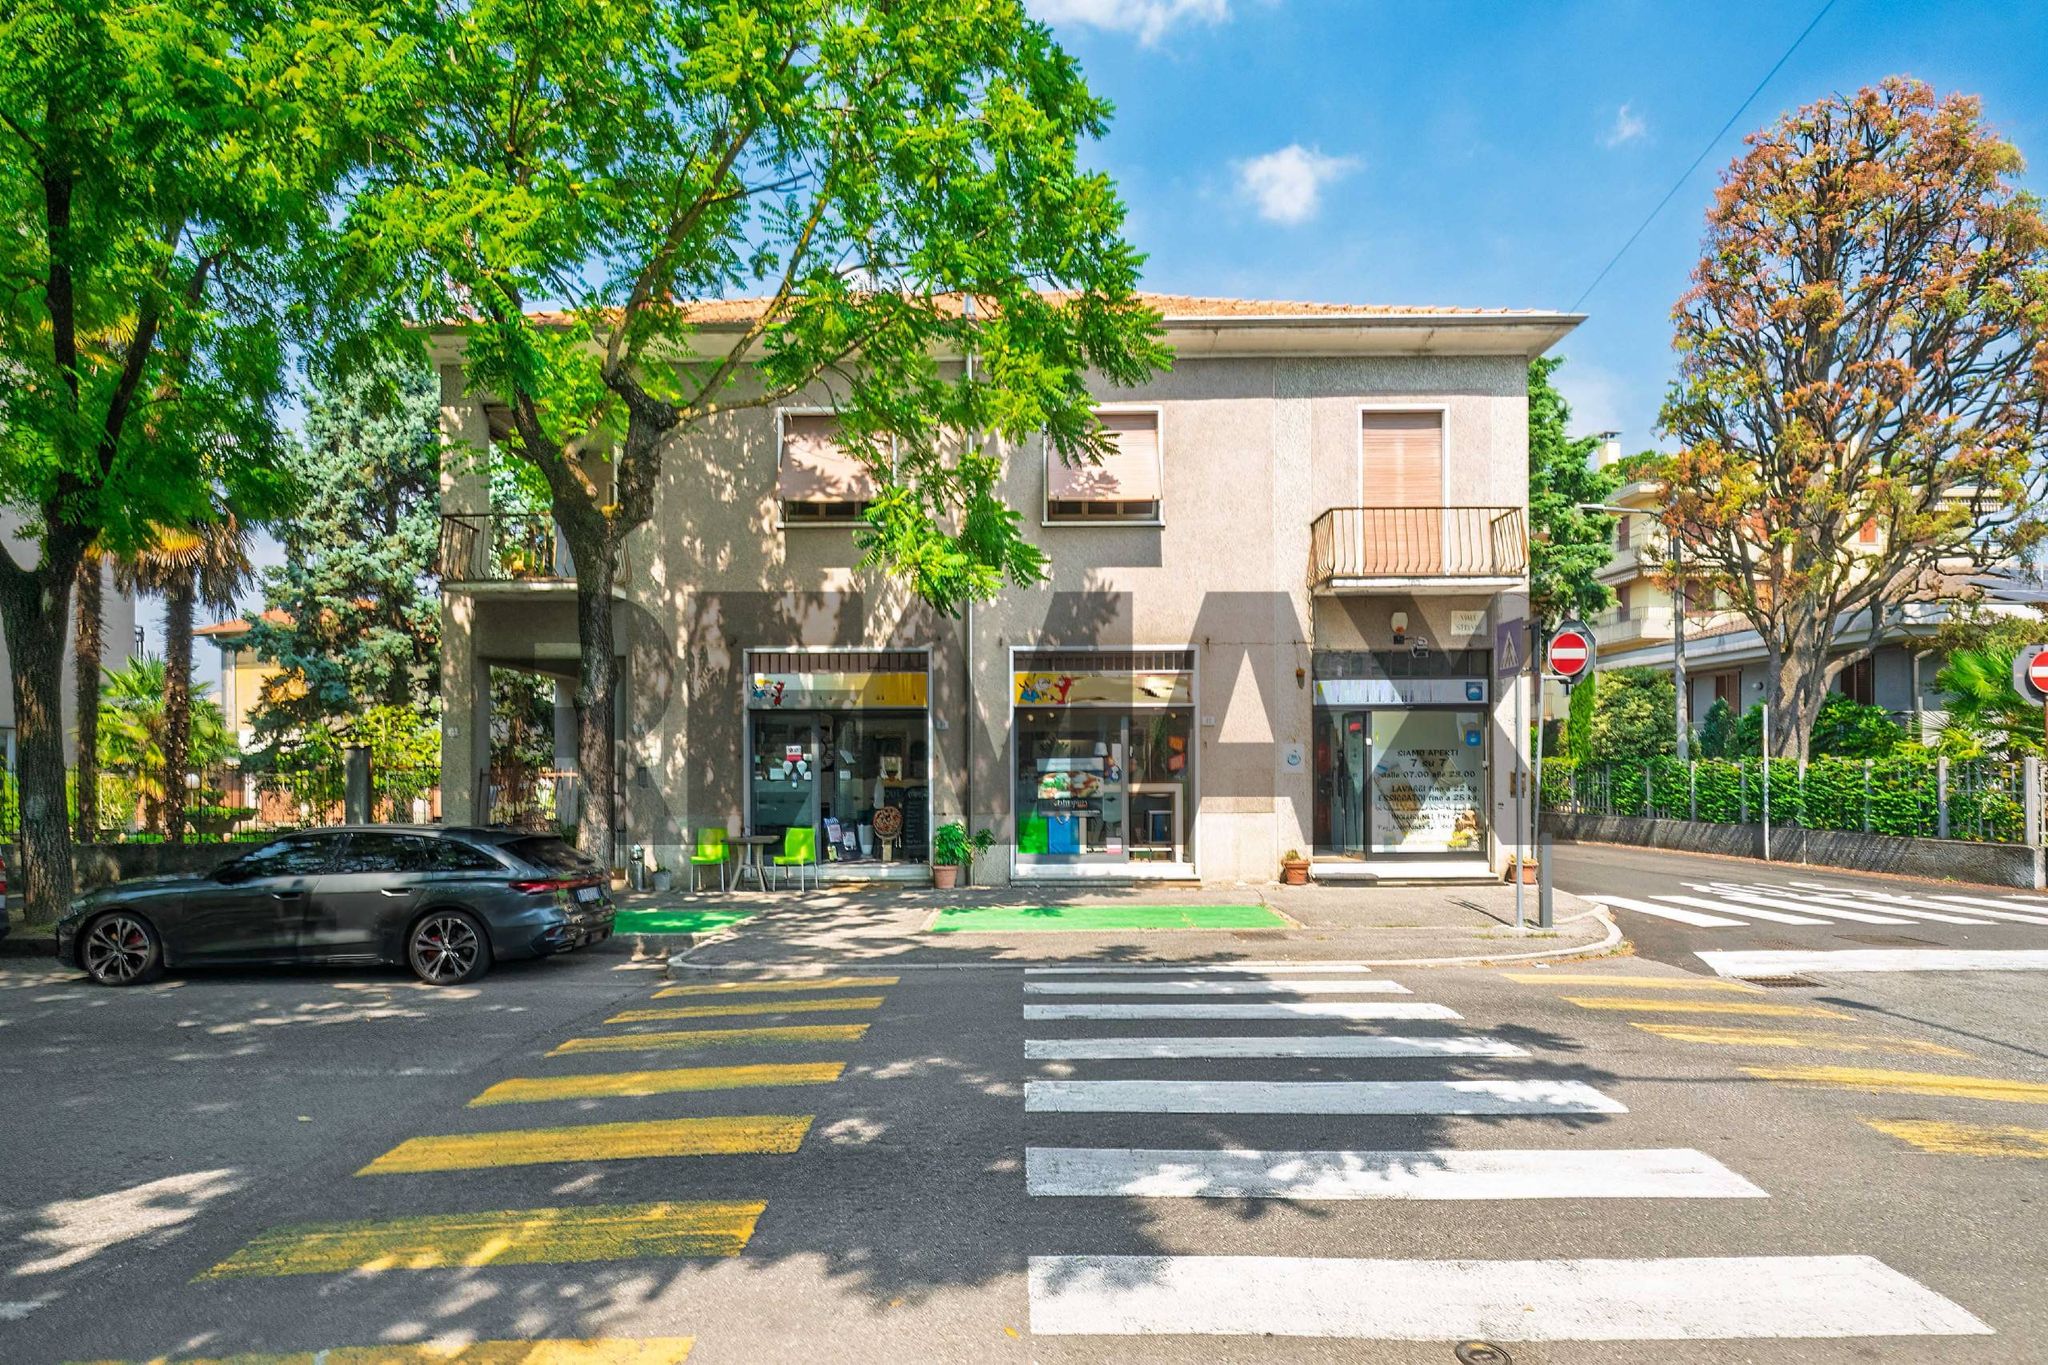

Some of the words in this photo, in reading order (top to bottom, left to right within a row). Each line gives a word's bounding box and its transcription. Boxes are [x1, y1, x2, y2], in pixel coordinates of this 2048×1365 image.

[1428, 749, 1459, 757] APERTI
[1411, 758, 1417, 767] 7
[1439, 758, 1446, 767] 7
